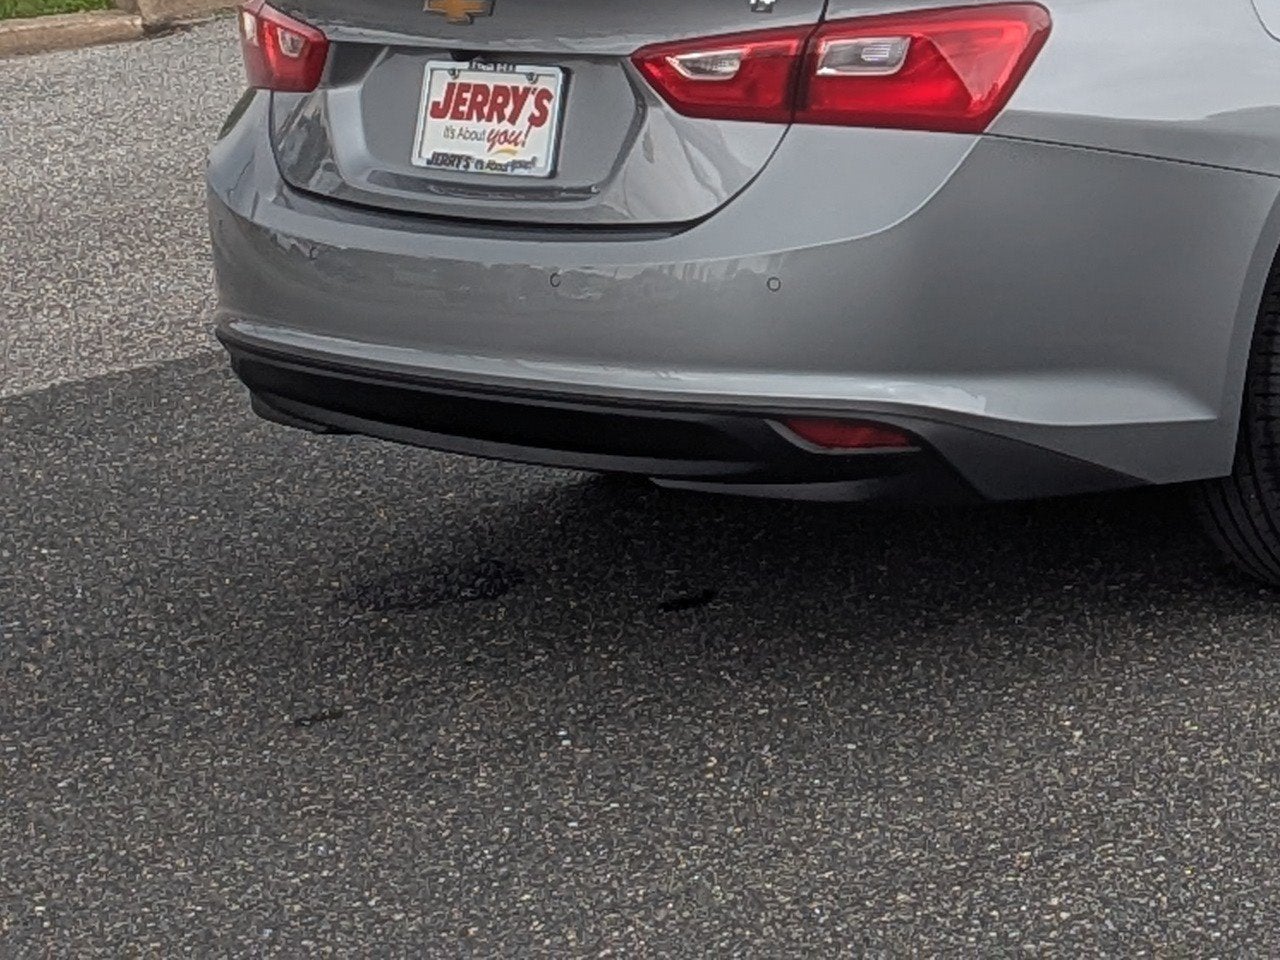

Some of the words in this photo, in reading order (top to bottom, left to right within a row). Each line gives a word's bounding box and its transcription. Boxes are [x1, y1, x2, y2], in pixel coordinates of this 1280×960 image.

[430, 81, 554, 128] JERRY'S
[457, 126, 486, 141] About
[486, 123, 533, 153] you!
